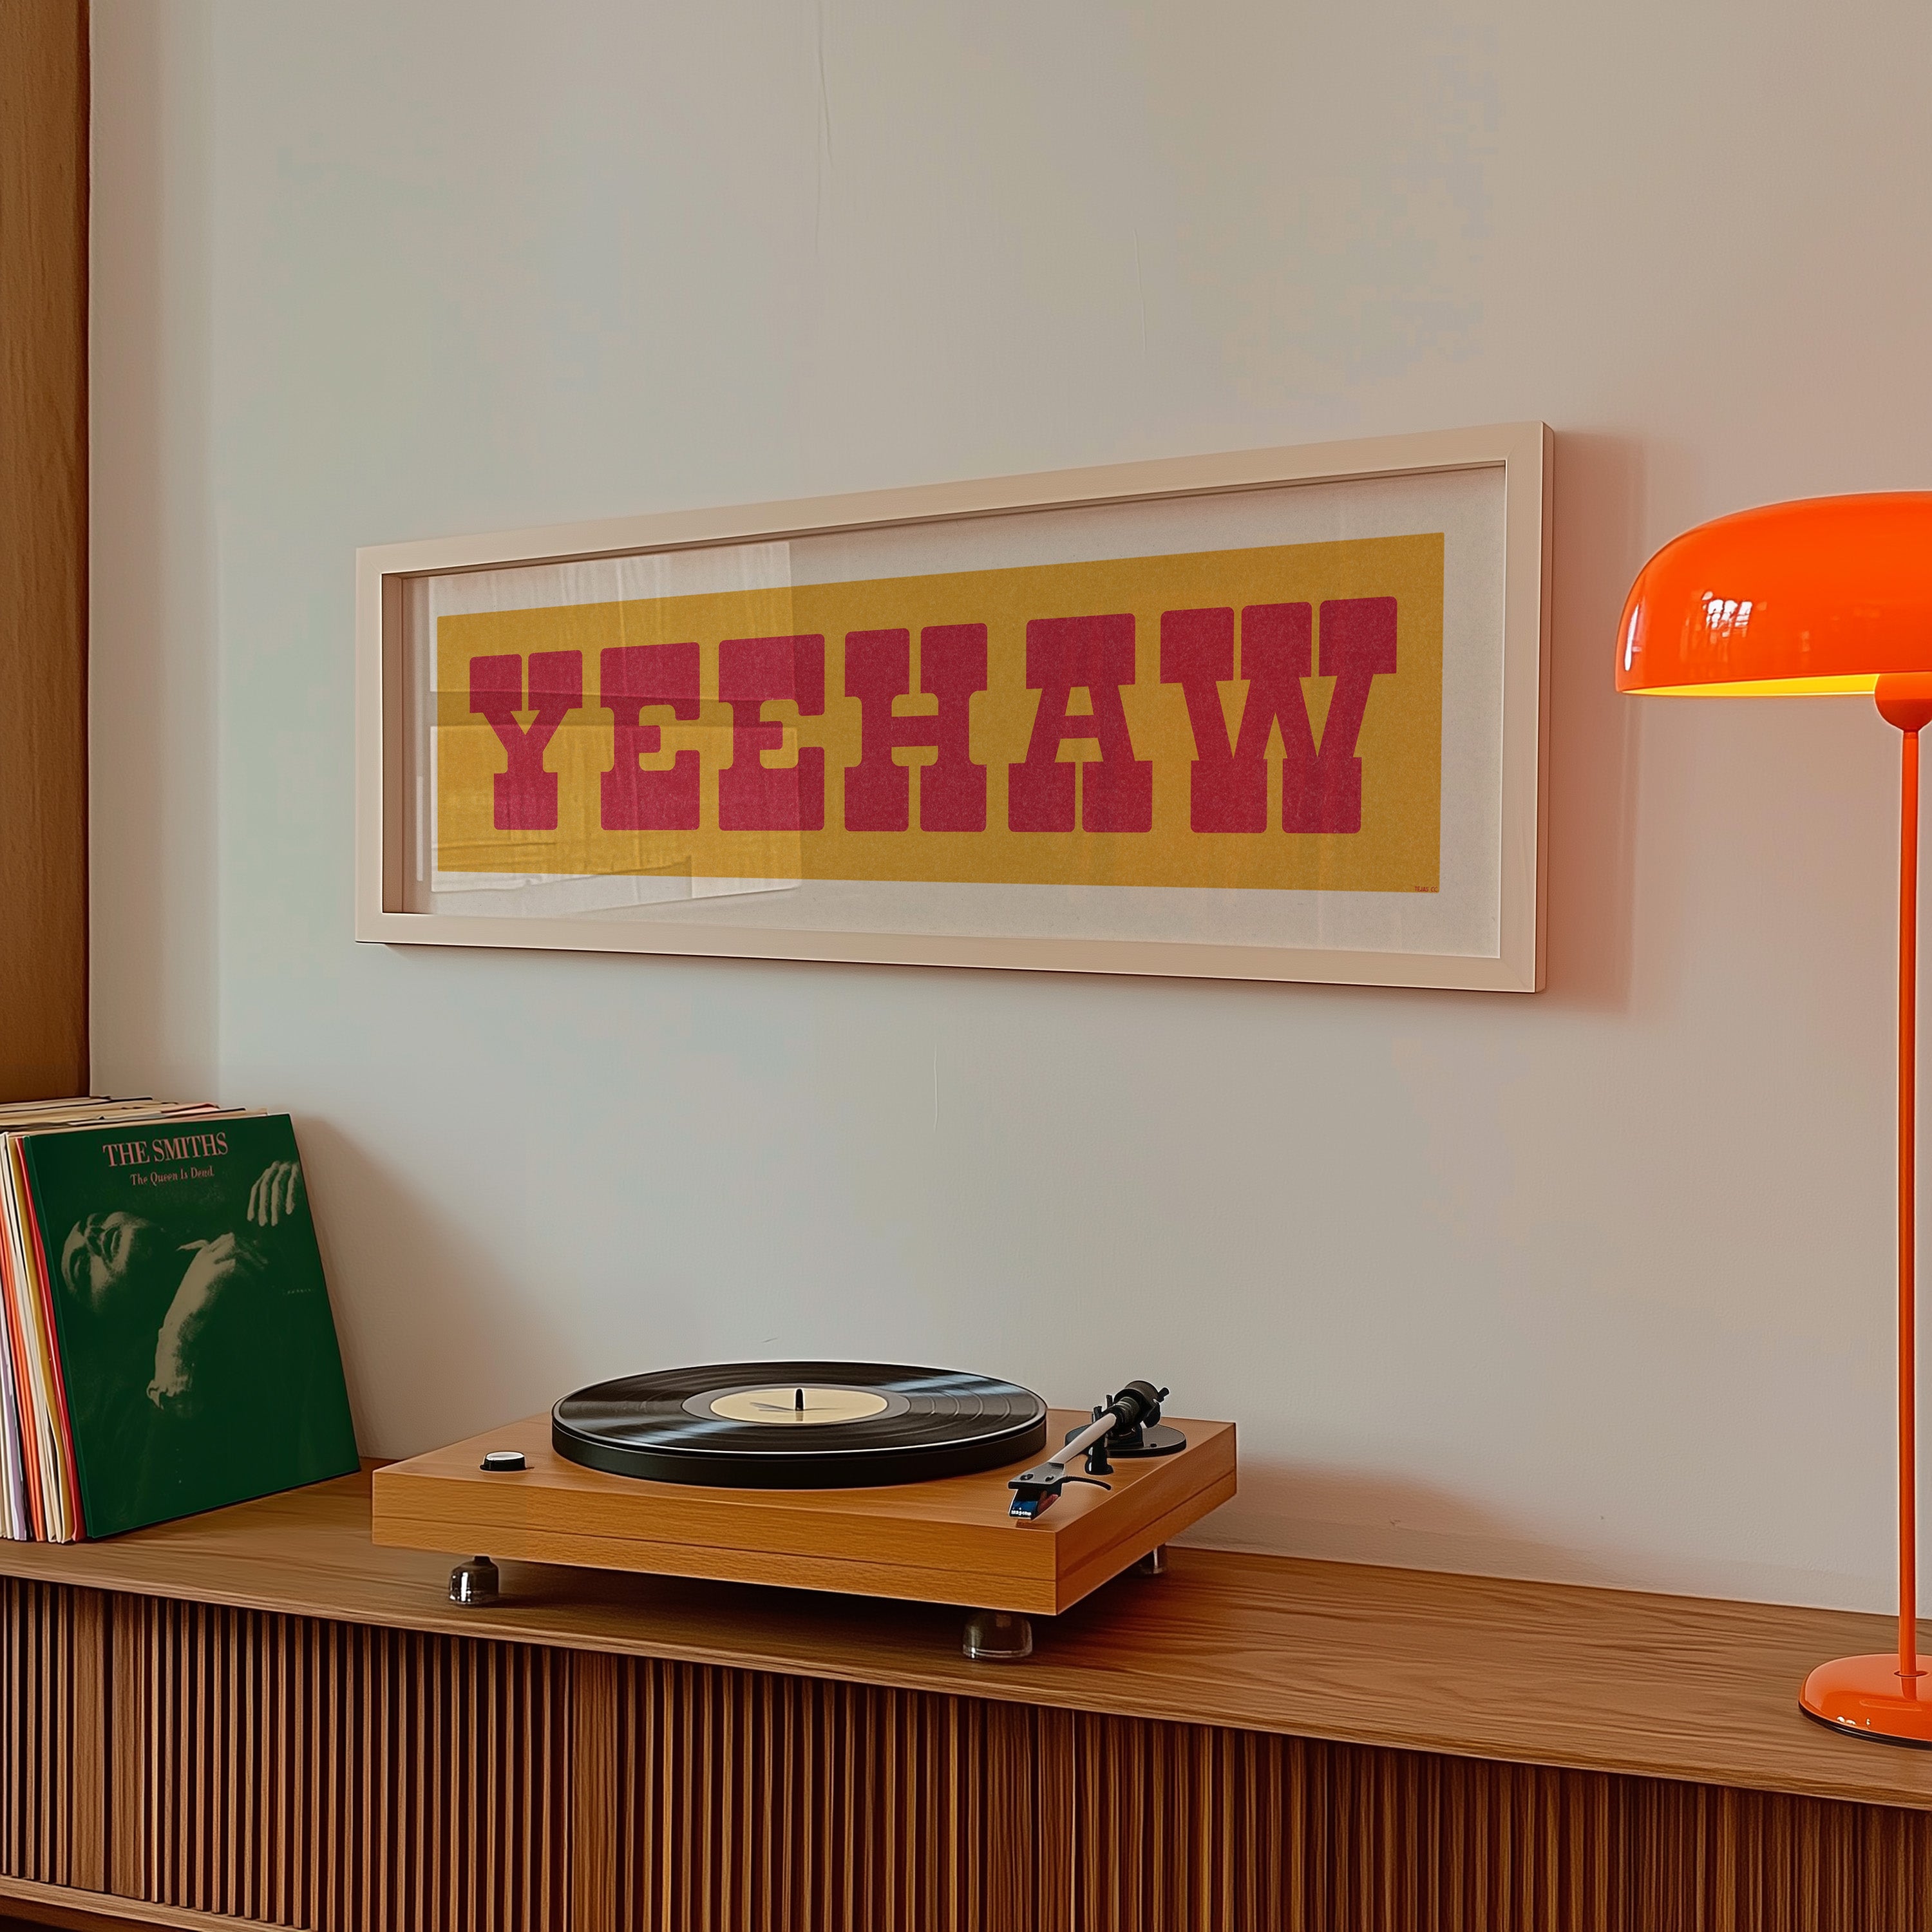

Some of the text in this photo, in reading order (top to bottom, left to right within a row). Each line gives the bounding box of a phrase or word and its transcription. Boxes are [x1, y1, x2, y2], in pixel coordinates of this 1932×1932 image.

[469, 596, 1397, 833] YEEHAW
[102, 1132, 229, 1167] THE SMITHS
[130, 1165, 214, 1186] The Queen Is Dead
